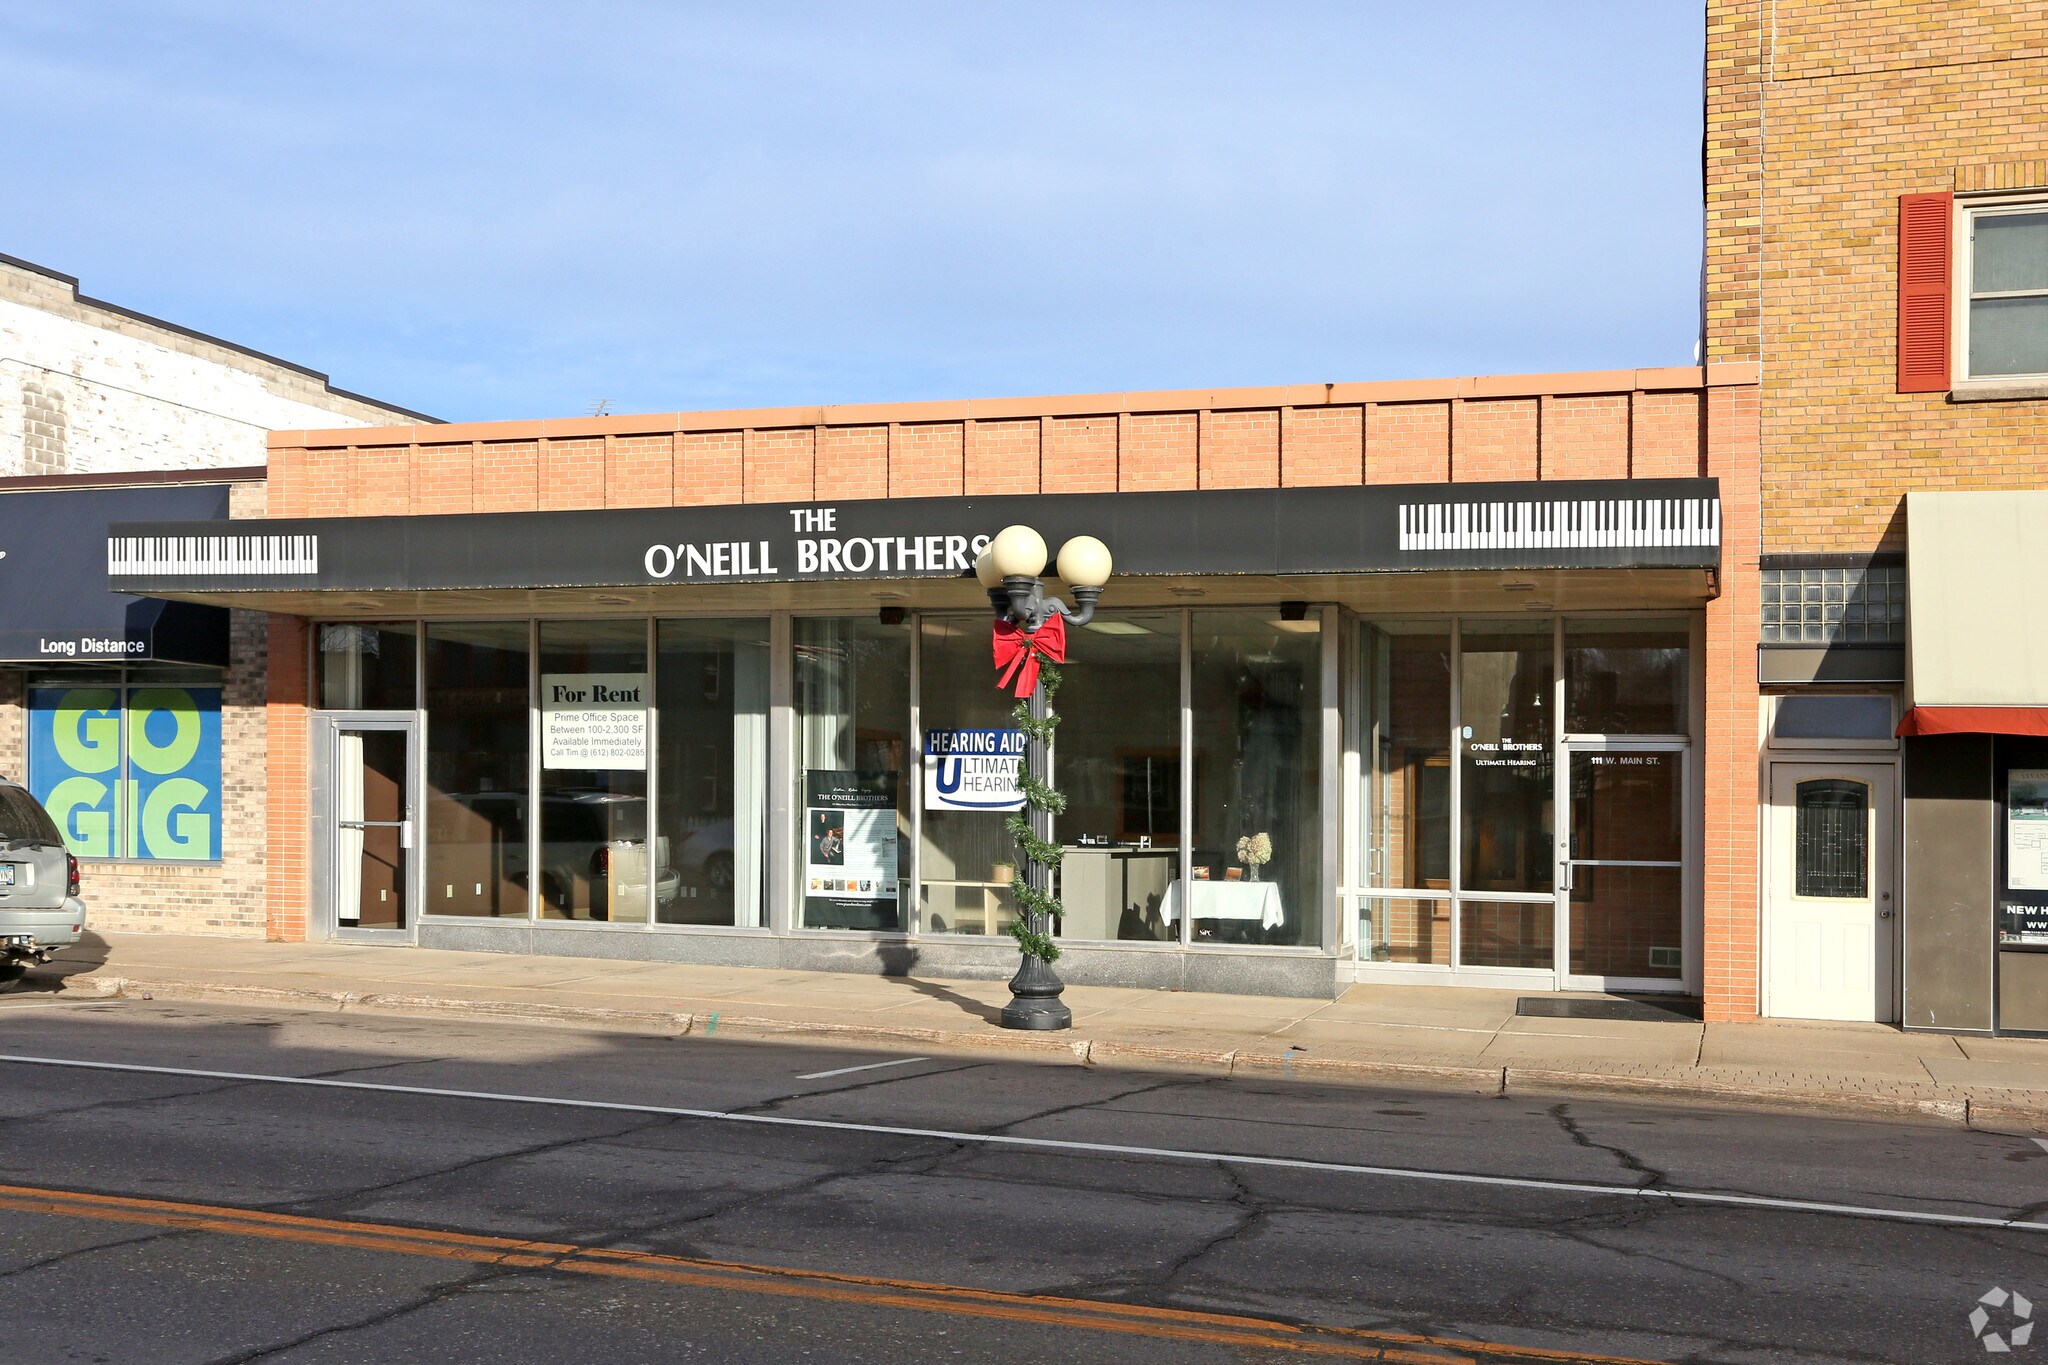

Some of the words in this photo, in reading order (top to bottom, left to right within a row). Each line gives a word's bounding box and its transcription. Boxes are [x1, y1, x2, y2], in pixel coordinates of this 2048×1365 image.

[790, 508, 837, 533] THE
[644, 541, 778, 579] O'NEILL
[40, 638, 76, 656] Long
[81, 638, 145, 653] Distance
[552, 685, 587, 703] For
[592, 684, 641, 703] Rent
[554, 712, 580, 722] Prime
[582, 712, 608, 722] Office
[610, 712, 639, 723] Space
[52, 687, 201, 775] GO
[550, 725, 585, 734] Between
[588, 725, 629, 735] 100-2,300
[631, 724, 644, 734] SF
[552, 738, 589, 746] Available
[591, 737, 642, 747] Immediately
[930, 732, 996, 753] HEARING
[1000, 731, 1028, 753] AID
[1470, 743, 1500, 751] O'NEILL
[1502, 743, 1543, 751] BROTHERS
[550, 748, 564, 757] Call
[566, 748, 579, 757] Tim
[590, 748, 609, 757] (612)
[1591, 756, 1603, 765] 111
[1605, 757, 1617, 765] W.
[1620, 757, 1643, 765] MAIN
[1646, 757, 1660, 765] ST.
[963, 776, 1018, 792] HEARIN
[44, 776, 211, 860] GIG
[2006, 905, 2038, 915] NEW
